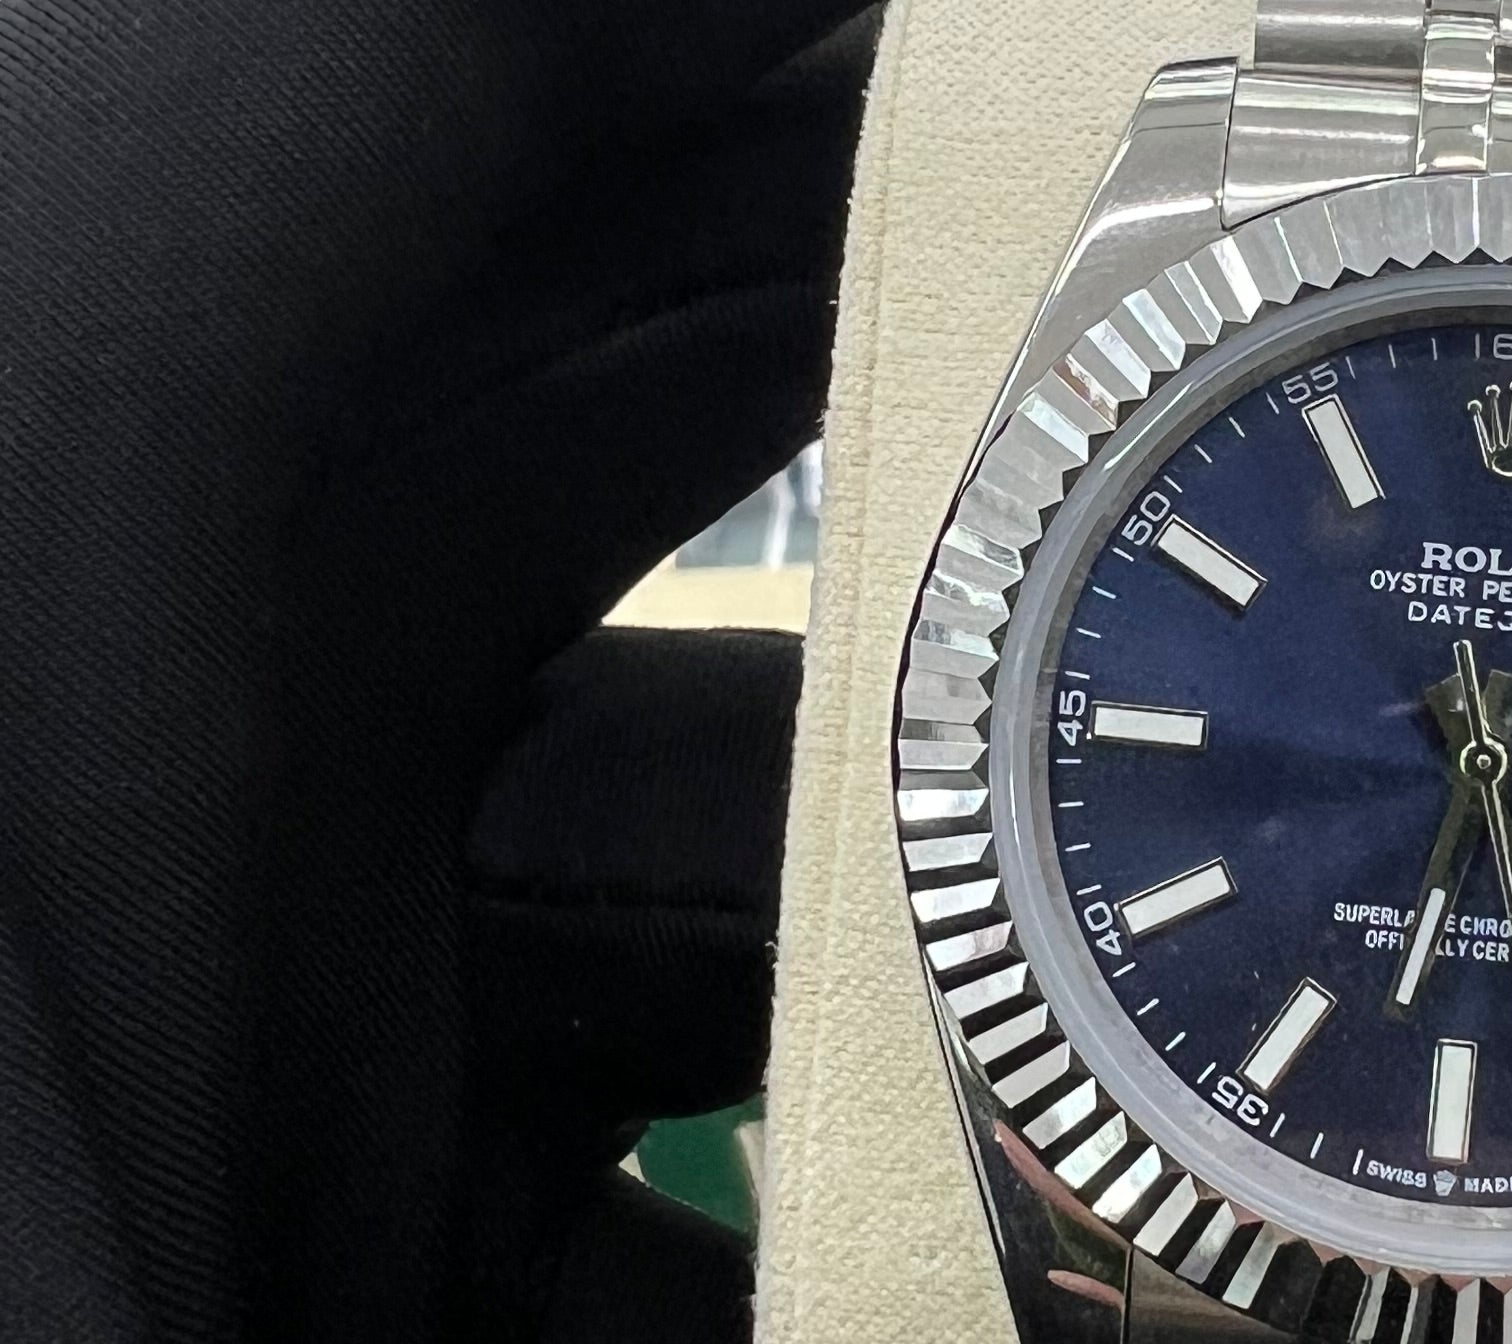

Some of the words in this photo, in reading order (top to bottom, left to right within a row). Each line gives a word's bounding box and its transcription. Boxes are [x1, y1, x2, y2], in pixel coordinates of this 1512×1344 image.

[1283, 363, 1339, 405] 55
[1121, 491, 1171, 546] 50
[1369, 569, 1465, 598] OYSTER
[1057, 689, 1087, 747] 45
[1083, 901, 1121, 956] 40
[1211, 1075, 1269, 1126] 35
[1366, 1159, 1427, 1188] SWISS
